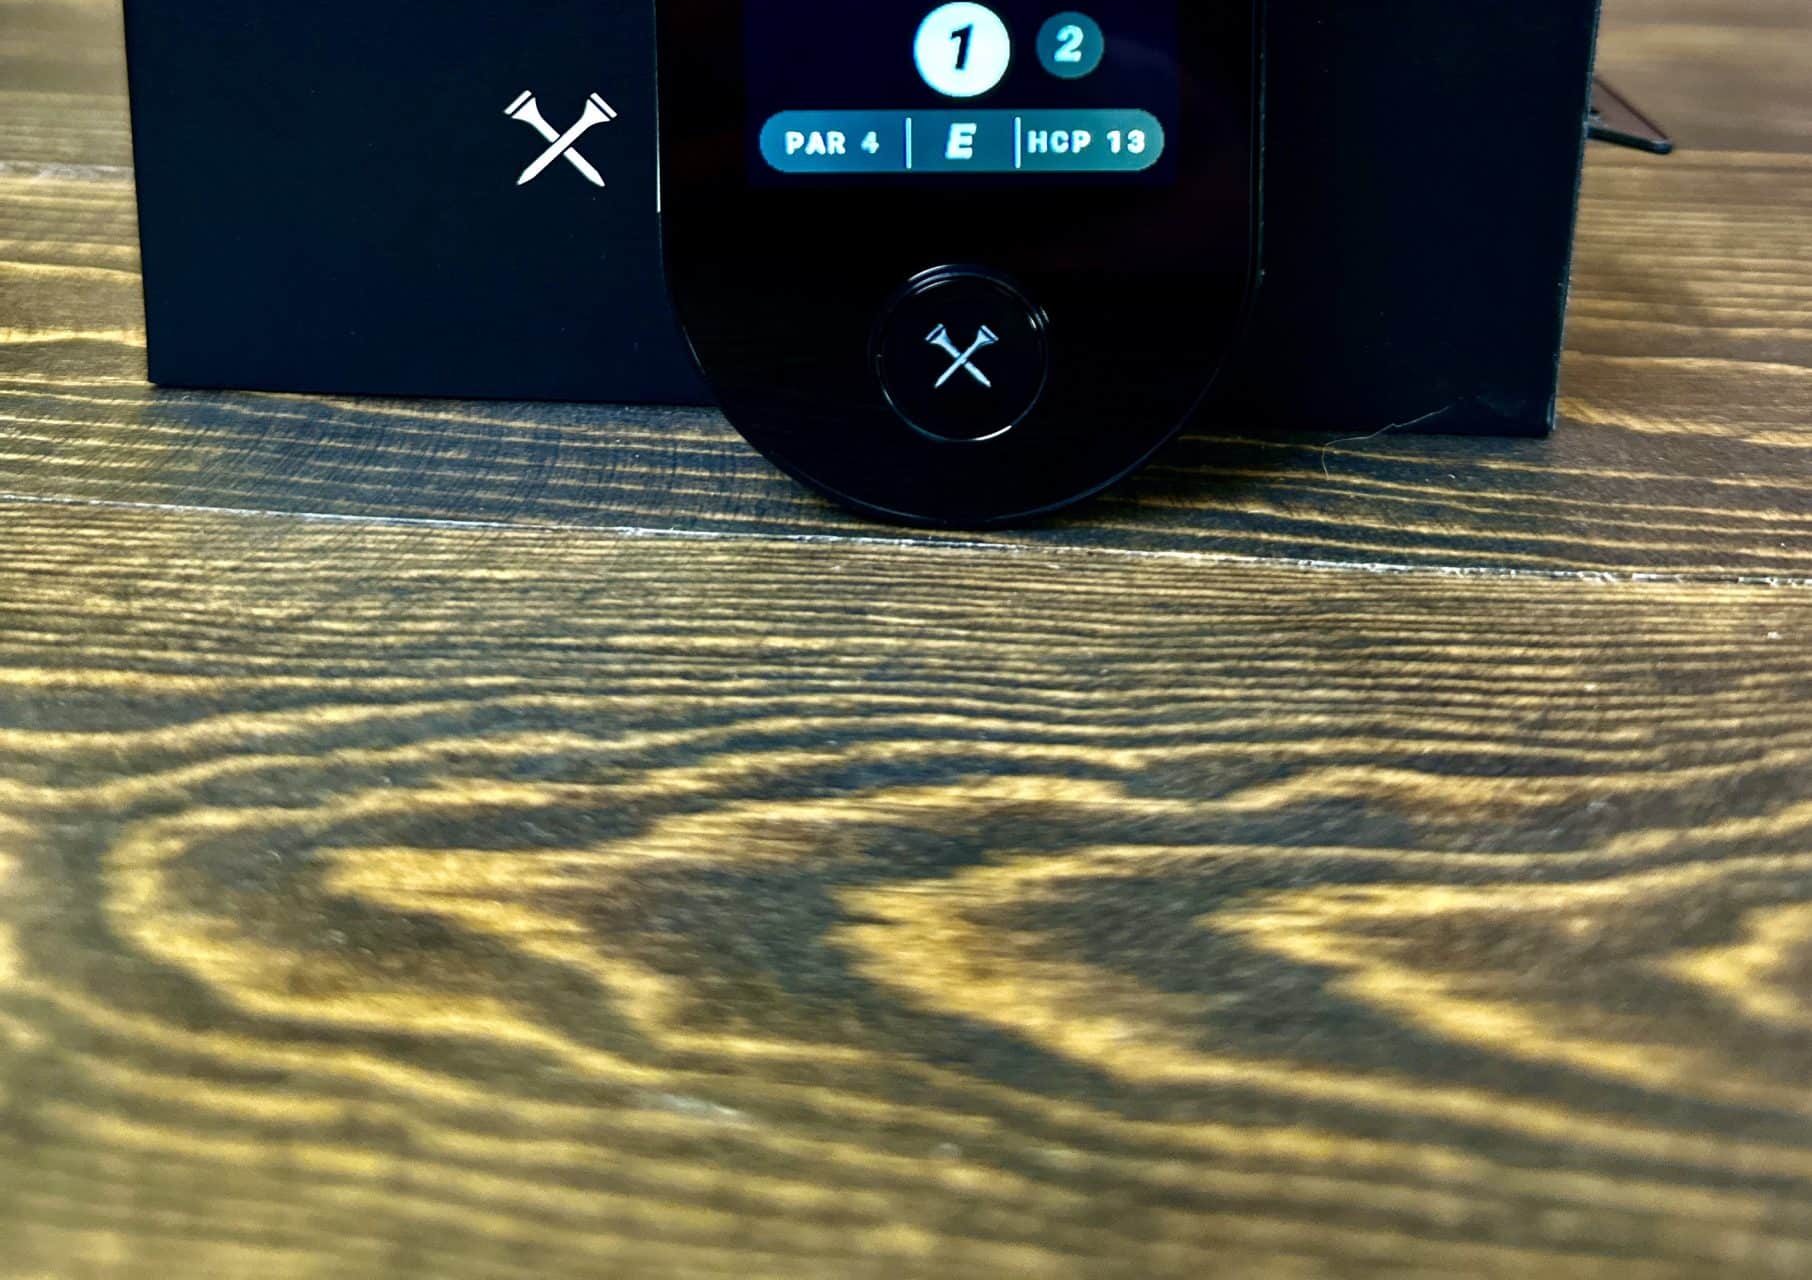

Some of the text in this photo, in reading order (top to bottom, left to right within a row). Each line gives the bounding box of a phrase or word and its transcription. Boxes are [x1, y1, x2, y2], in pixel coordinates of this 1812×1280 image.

[951, 24, 1084, 70] 1 2
[785, 123, 1145, 160] PAR 4 E HCP 13
